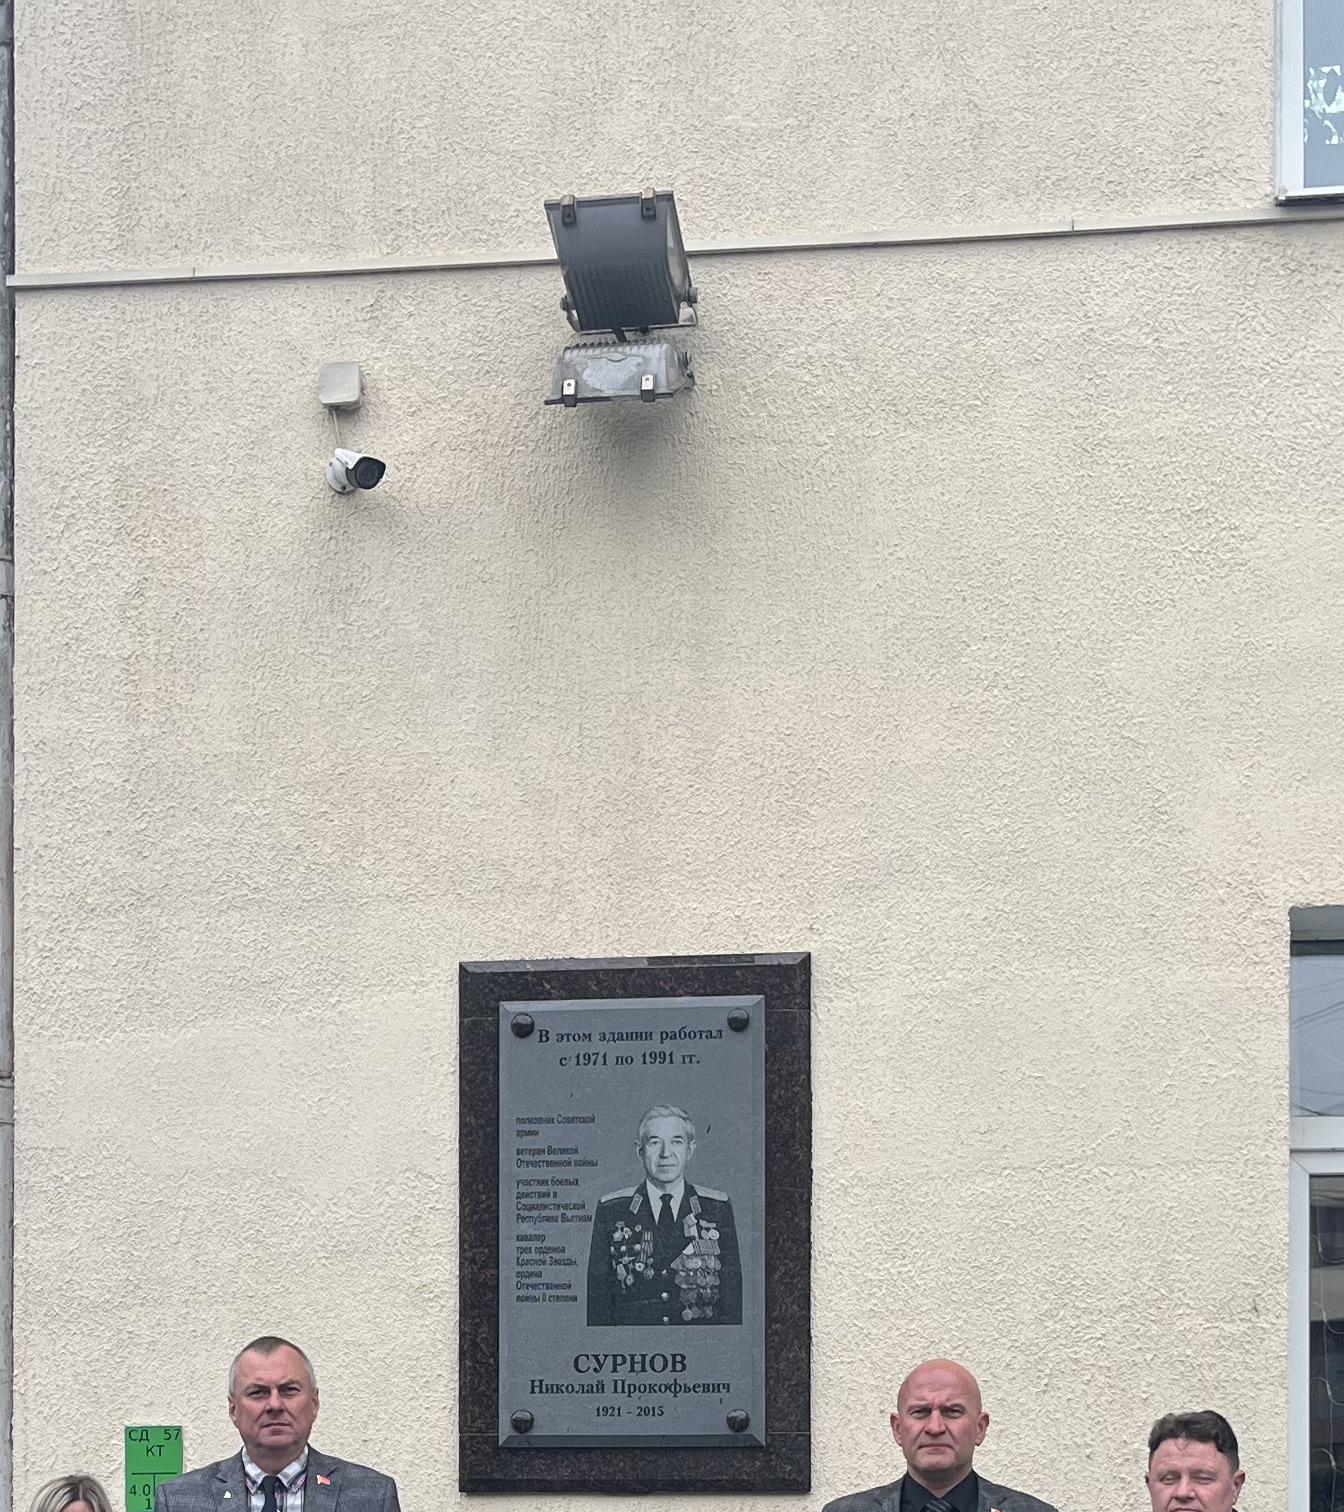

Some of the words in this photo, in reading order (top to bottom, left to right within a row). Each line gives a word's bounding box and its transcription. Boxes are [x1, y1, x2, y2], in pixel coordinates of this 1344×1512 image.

[538, 1029, 550, 1043] В
[556, 1031, 593, 1043] этом
[599, 1030, 654, 1044] здании
[659, 1025, 724, 1044] работал
[559, 1055, 568, 1067] с
[574, 1051, 608, 1067] 1971
[614, 1054, 634, 1066] по
[641, 1050, 675, 1065] 1991
[681, 1053, 701, 1065] гг.
[572, 1353, 687, 1374] СУРНОВ
[529, 1379, 605, 1394] Николай
[611, 1378, 731, 1398] Прокофьевич
[595, 1406, 621, 1417] 1921
[636, 1406, 664, 1417] 2015
[128, 1429, 150, 1443] СД
[163, 1428, 181, 1441] 57
[146, 1444, 165, 1457] КТ
